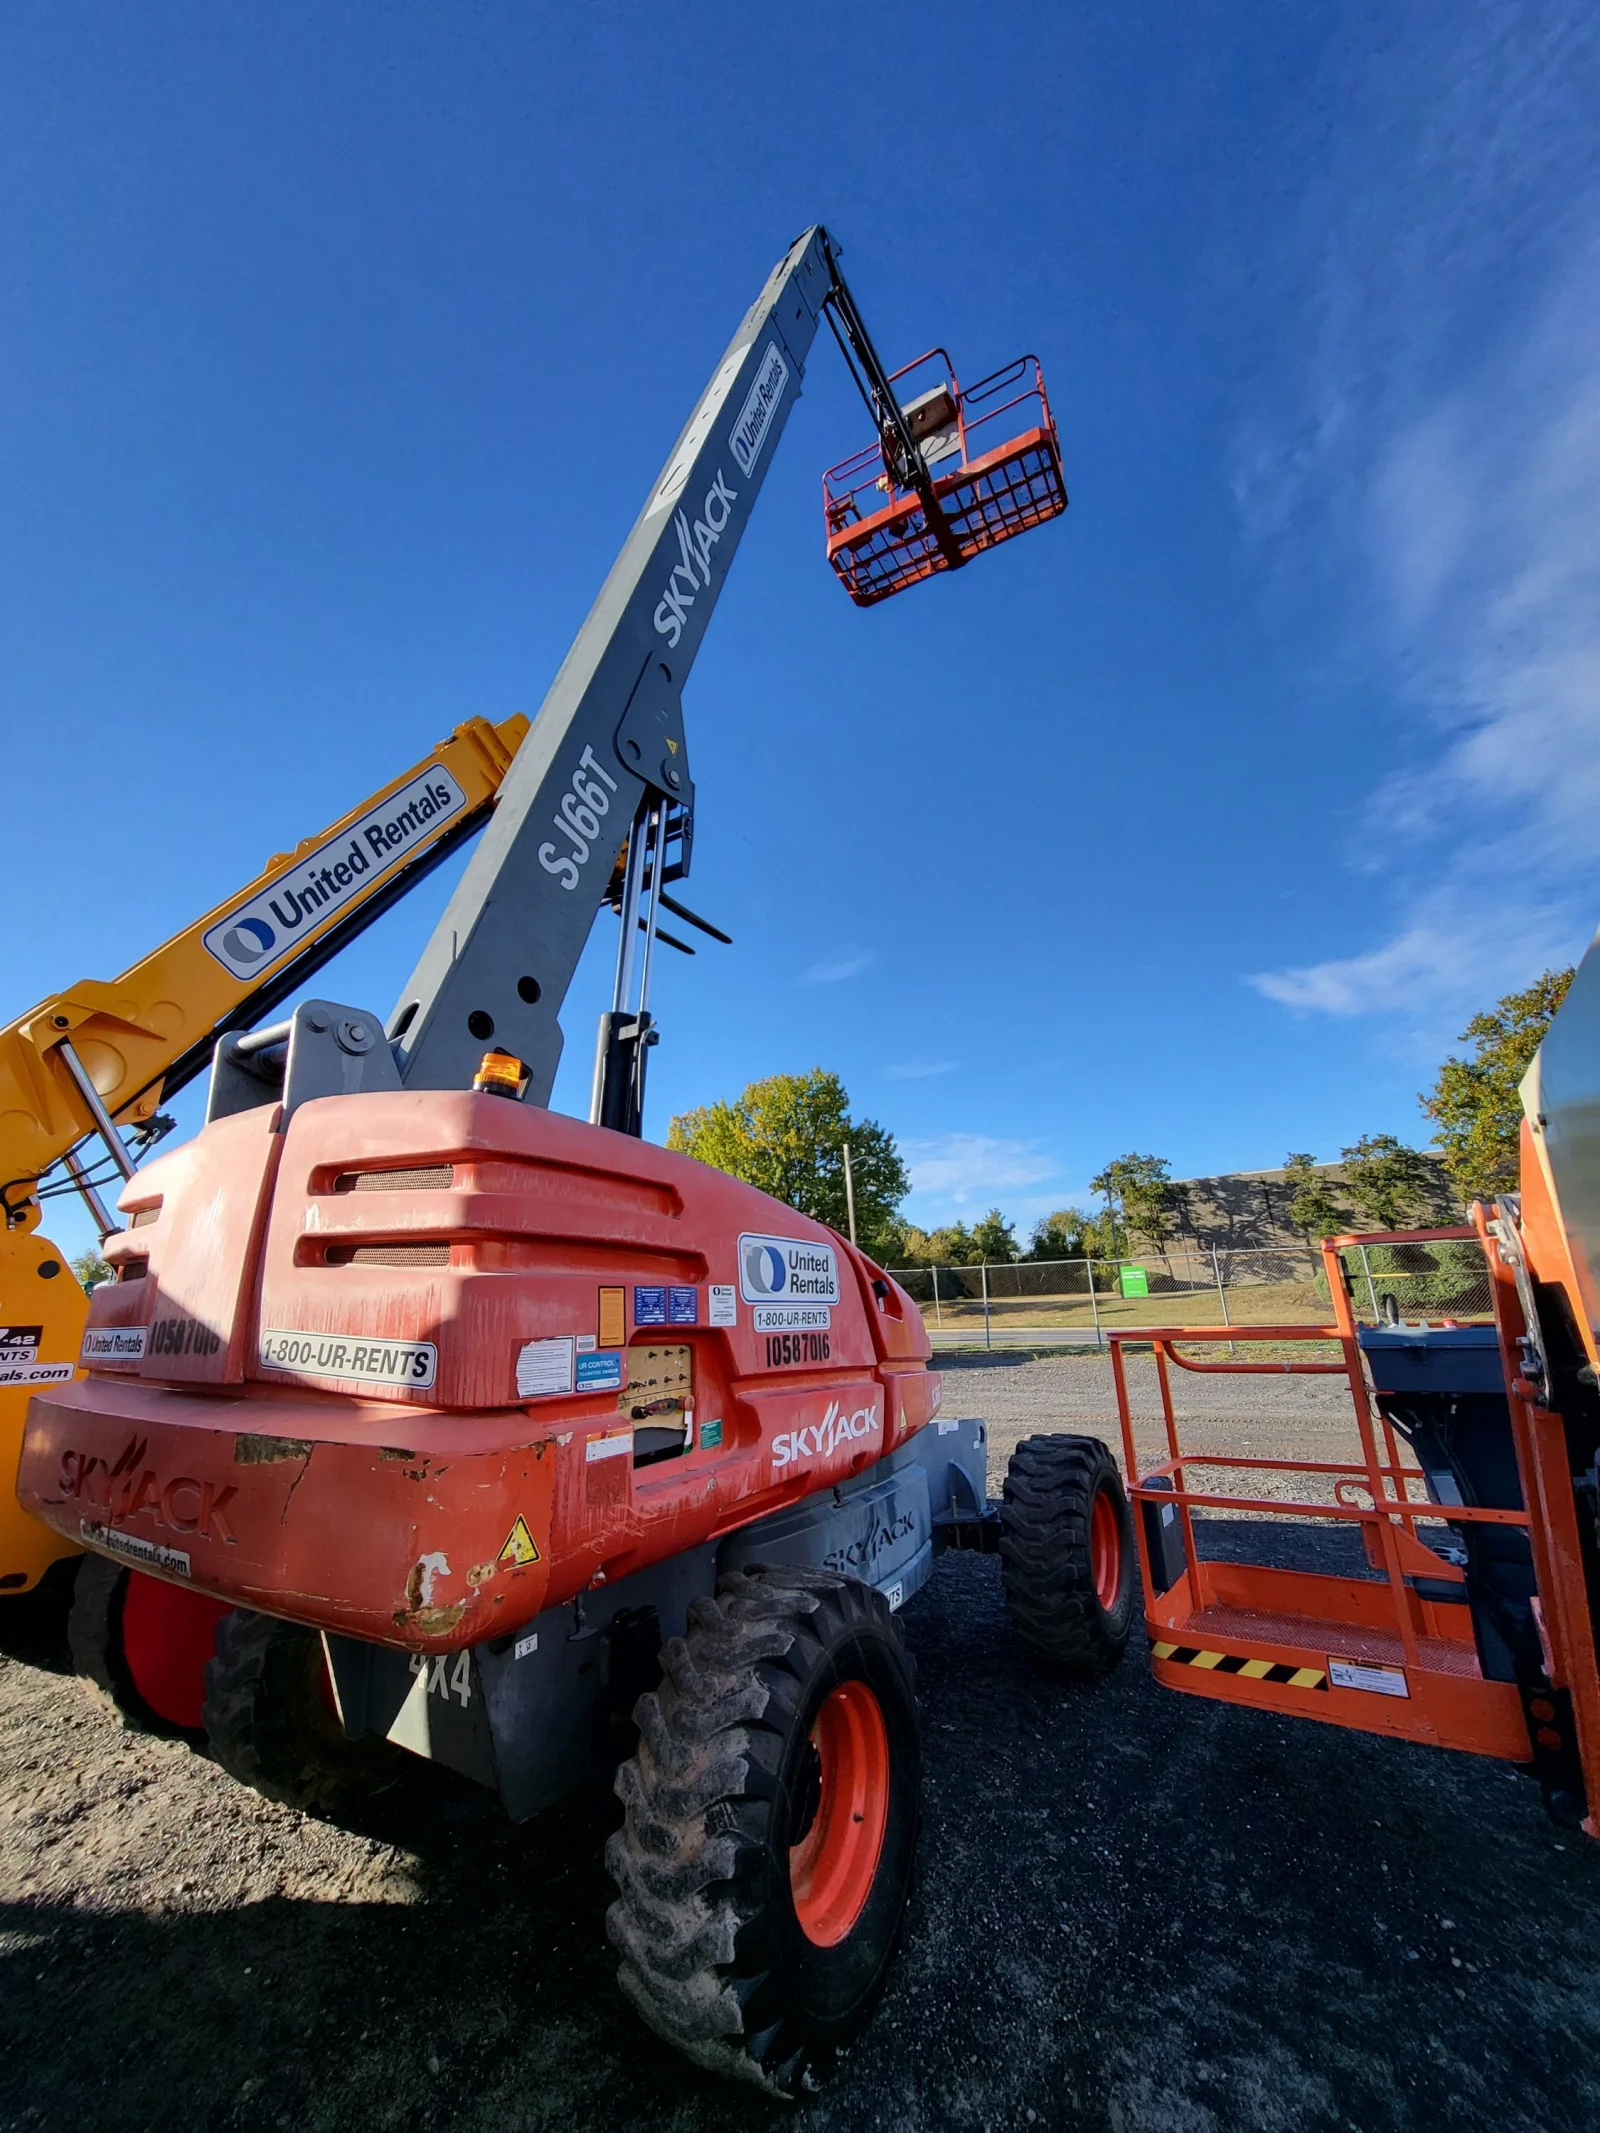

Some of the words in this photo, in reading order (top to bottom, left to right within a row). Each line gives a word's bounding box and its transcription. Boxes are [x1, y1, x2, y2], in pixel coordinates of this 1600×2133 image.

[742, 394, 767, 448] United
[759, 358, 783, 405] Rentals
[653, 467, 738, 649] SKYJACK
[538, 743, 618, 890] SJ66T
[269, 840, 370, 929] United
[363, 780, 451, 858] Rentals
[788, 1250, 829, 1273] United
[790, 1274, 834, 1295] Rentals
[92, 1335, 114, 1353] United
[114, 1332, 143, 1353] Rentals
[758, 1311, 828, 1326] 1-800-UR-RENTS
[264, 1338, 430, 1378] 1-800-UR-RENTS
[766, 1334, 830, 1367] 10587016
[772, 1399, 879, 1467] SKYJACK
[59, 1434, 239, 1545] SKYJACK
[823, 1510, 914, 1572] SKYJACK
